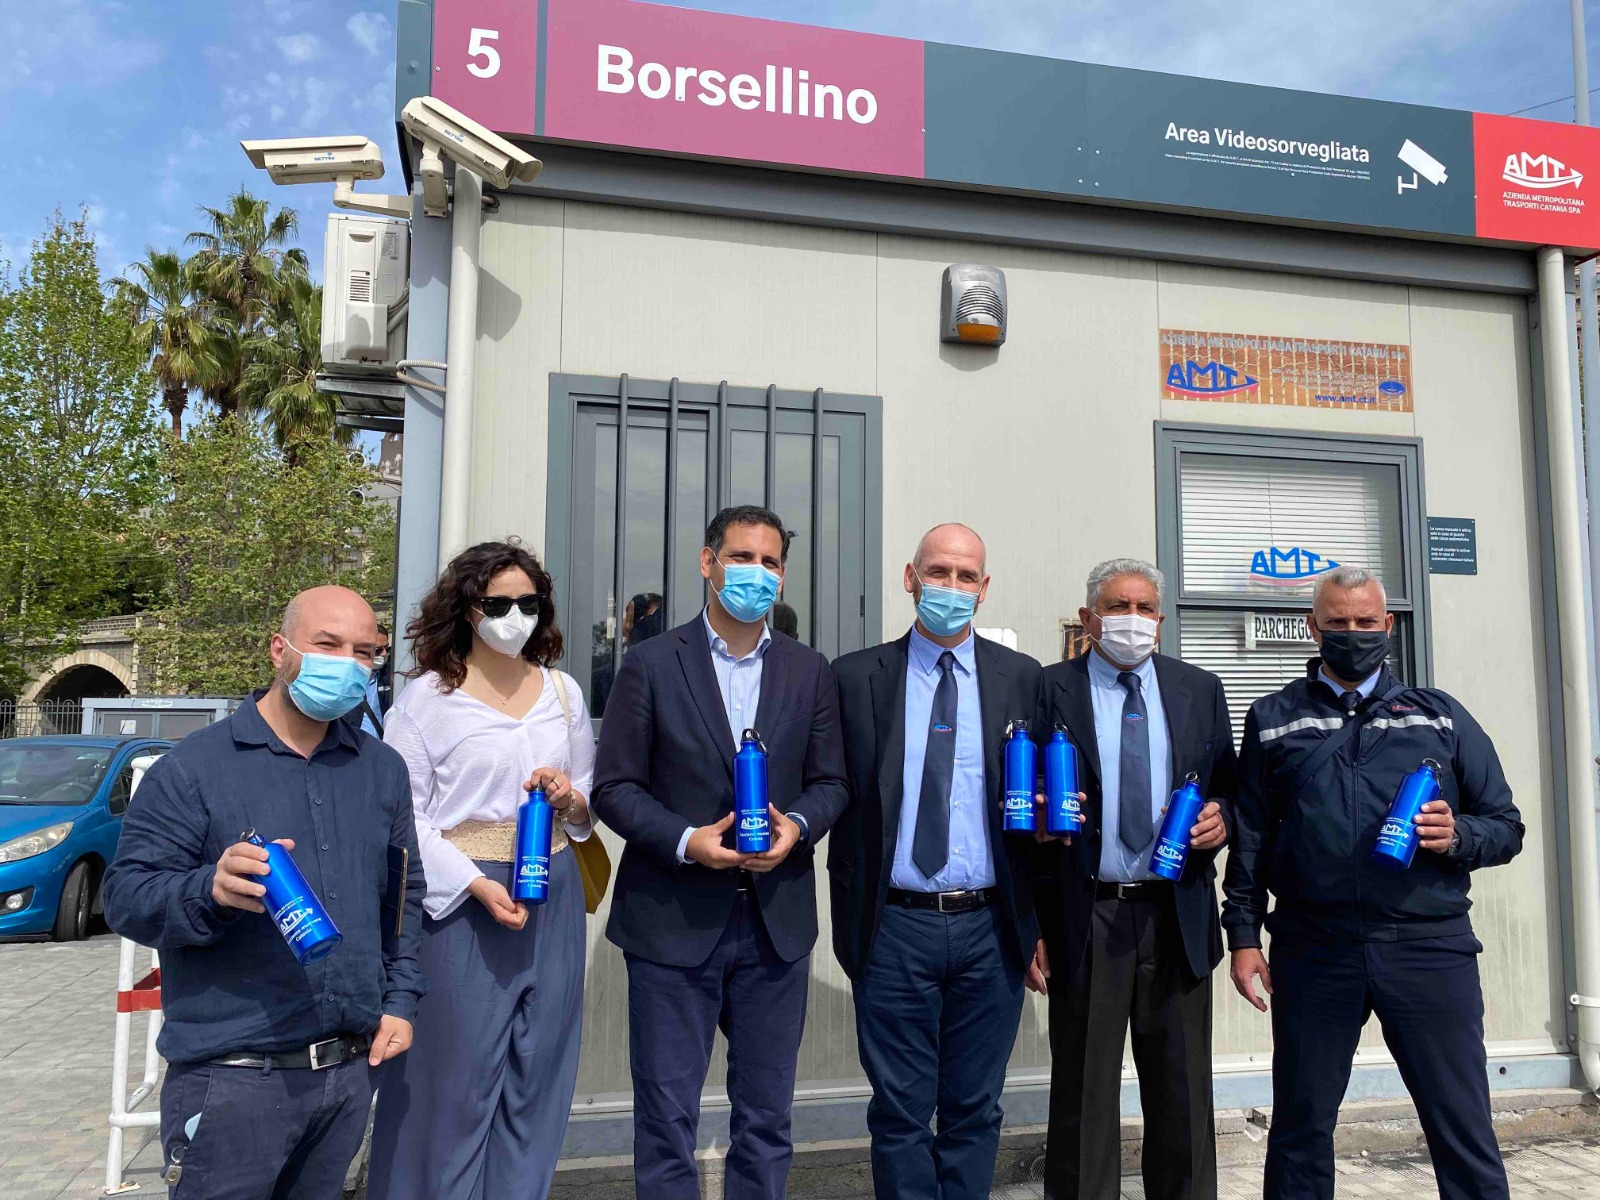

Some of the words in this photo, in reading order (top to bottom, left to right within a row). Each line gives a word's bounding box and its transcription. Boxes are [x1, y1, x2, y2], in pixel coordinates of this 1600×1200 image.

[465, 27, 501, 79] 5
[597, 43, 878, 125] Borsellino
[1164, 121, 1210, 145] Area
[1214, 127, 1370, 163] Videosorvegliata
[1502, 151, 1569, 184] AMT
[1502, 191, 1531, 201] AZIENDA
[1532, 194, 1585, 206] METROPOLITANA
[1503, 200, 1539, 210] TRASPORTI
[1540, 203, 1568, 213] CATANIA
[1568, 206, 1581, 214] SPA
[1161, 333, 1207, 347] AZIENDA
[1208, 336, 1292, 352] METROPOLITANA
[1293, 341, 1347, 356] TRASPORTI
[1348, 346, 1390, 359] CATANIA
[1166, 360, 1246, 393] AMT
[1314, 394, 1377, 404] www.amt.ct.it
[1250, 546, 1328, 579] AMT
[1006, 797, 1029, 809] AMT
[741, 817, 766, 829] AMT
[1157, 845, 1181, 859] AMT
[520, 863, 546, 876] AMT
[280, 908, 309, 935] AMT
